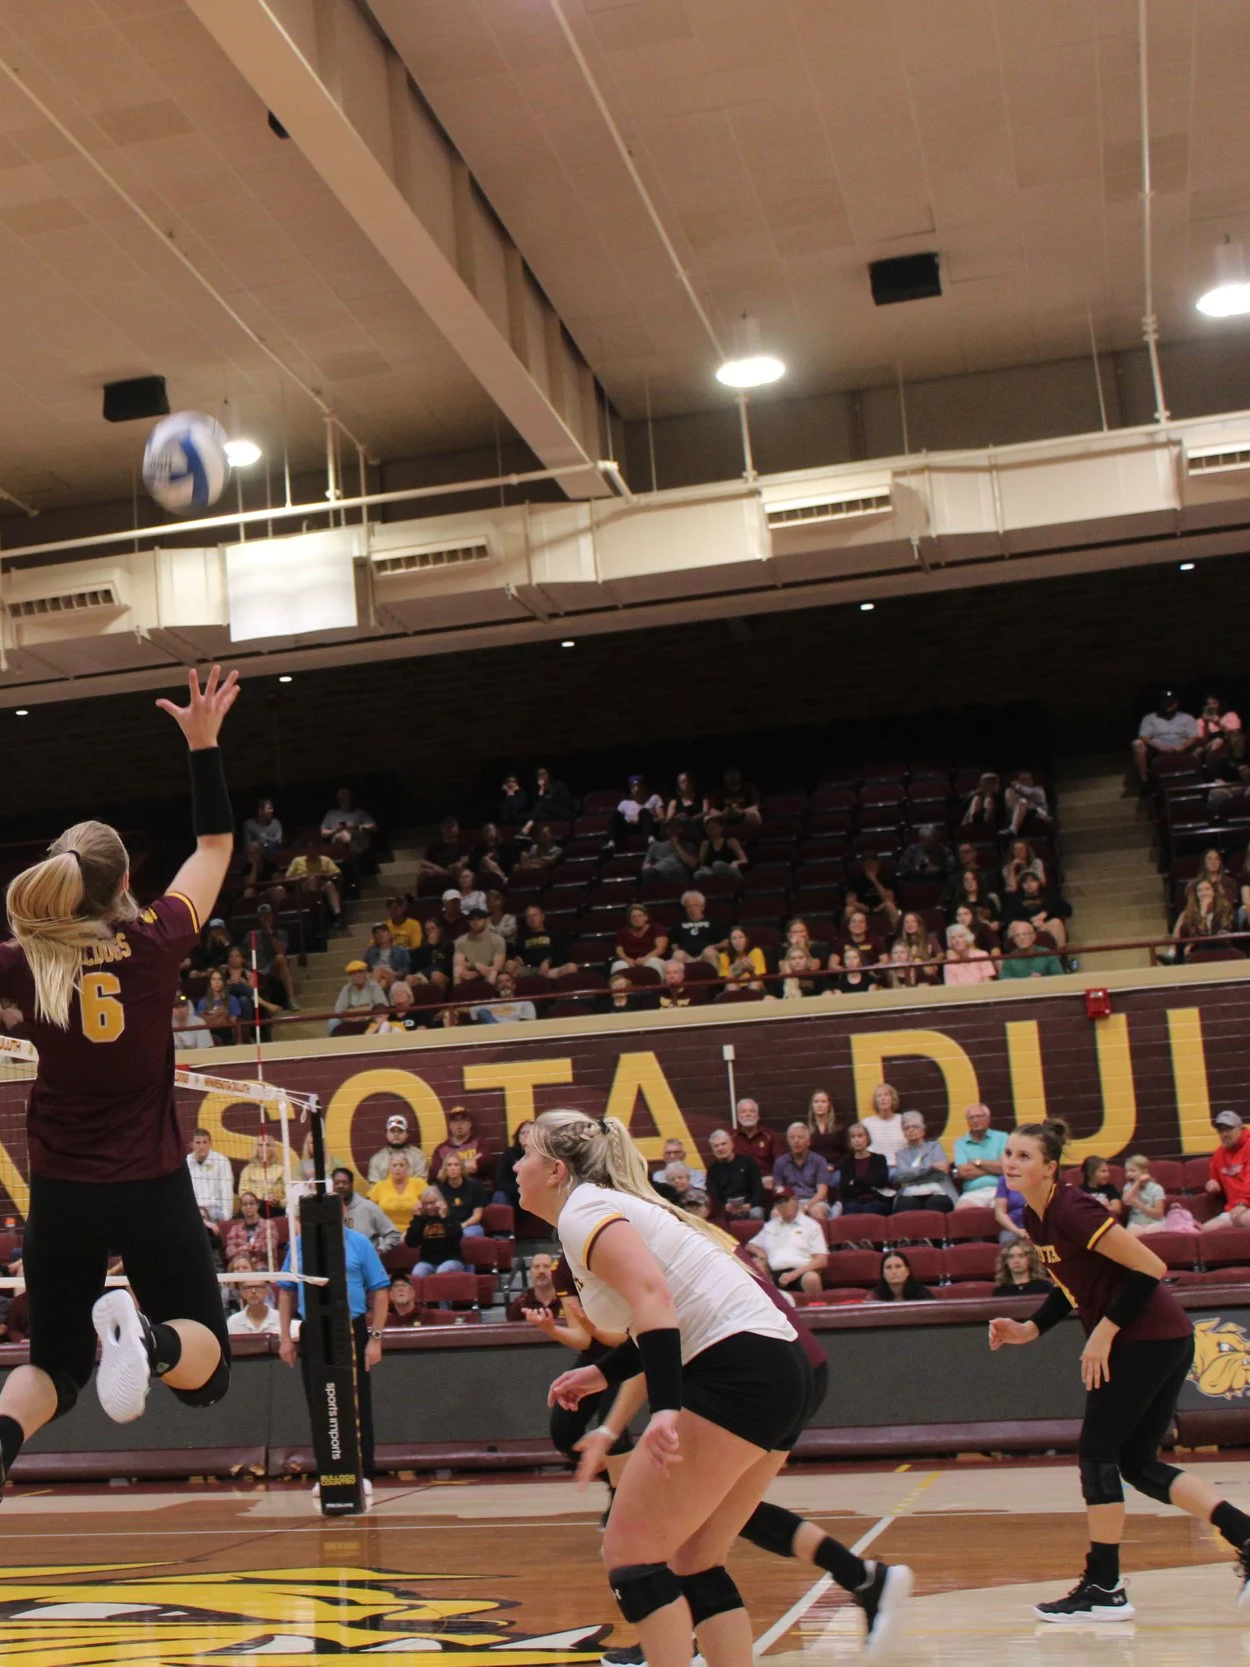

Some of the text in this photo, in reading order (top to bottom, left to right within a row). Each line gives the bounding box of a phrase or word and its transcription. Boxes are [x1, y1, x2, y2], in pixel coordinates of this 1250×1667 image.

[79, 971, 125, 1043] 6
[325, 1382, 342, 1460] sports imports
